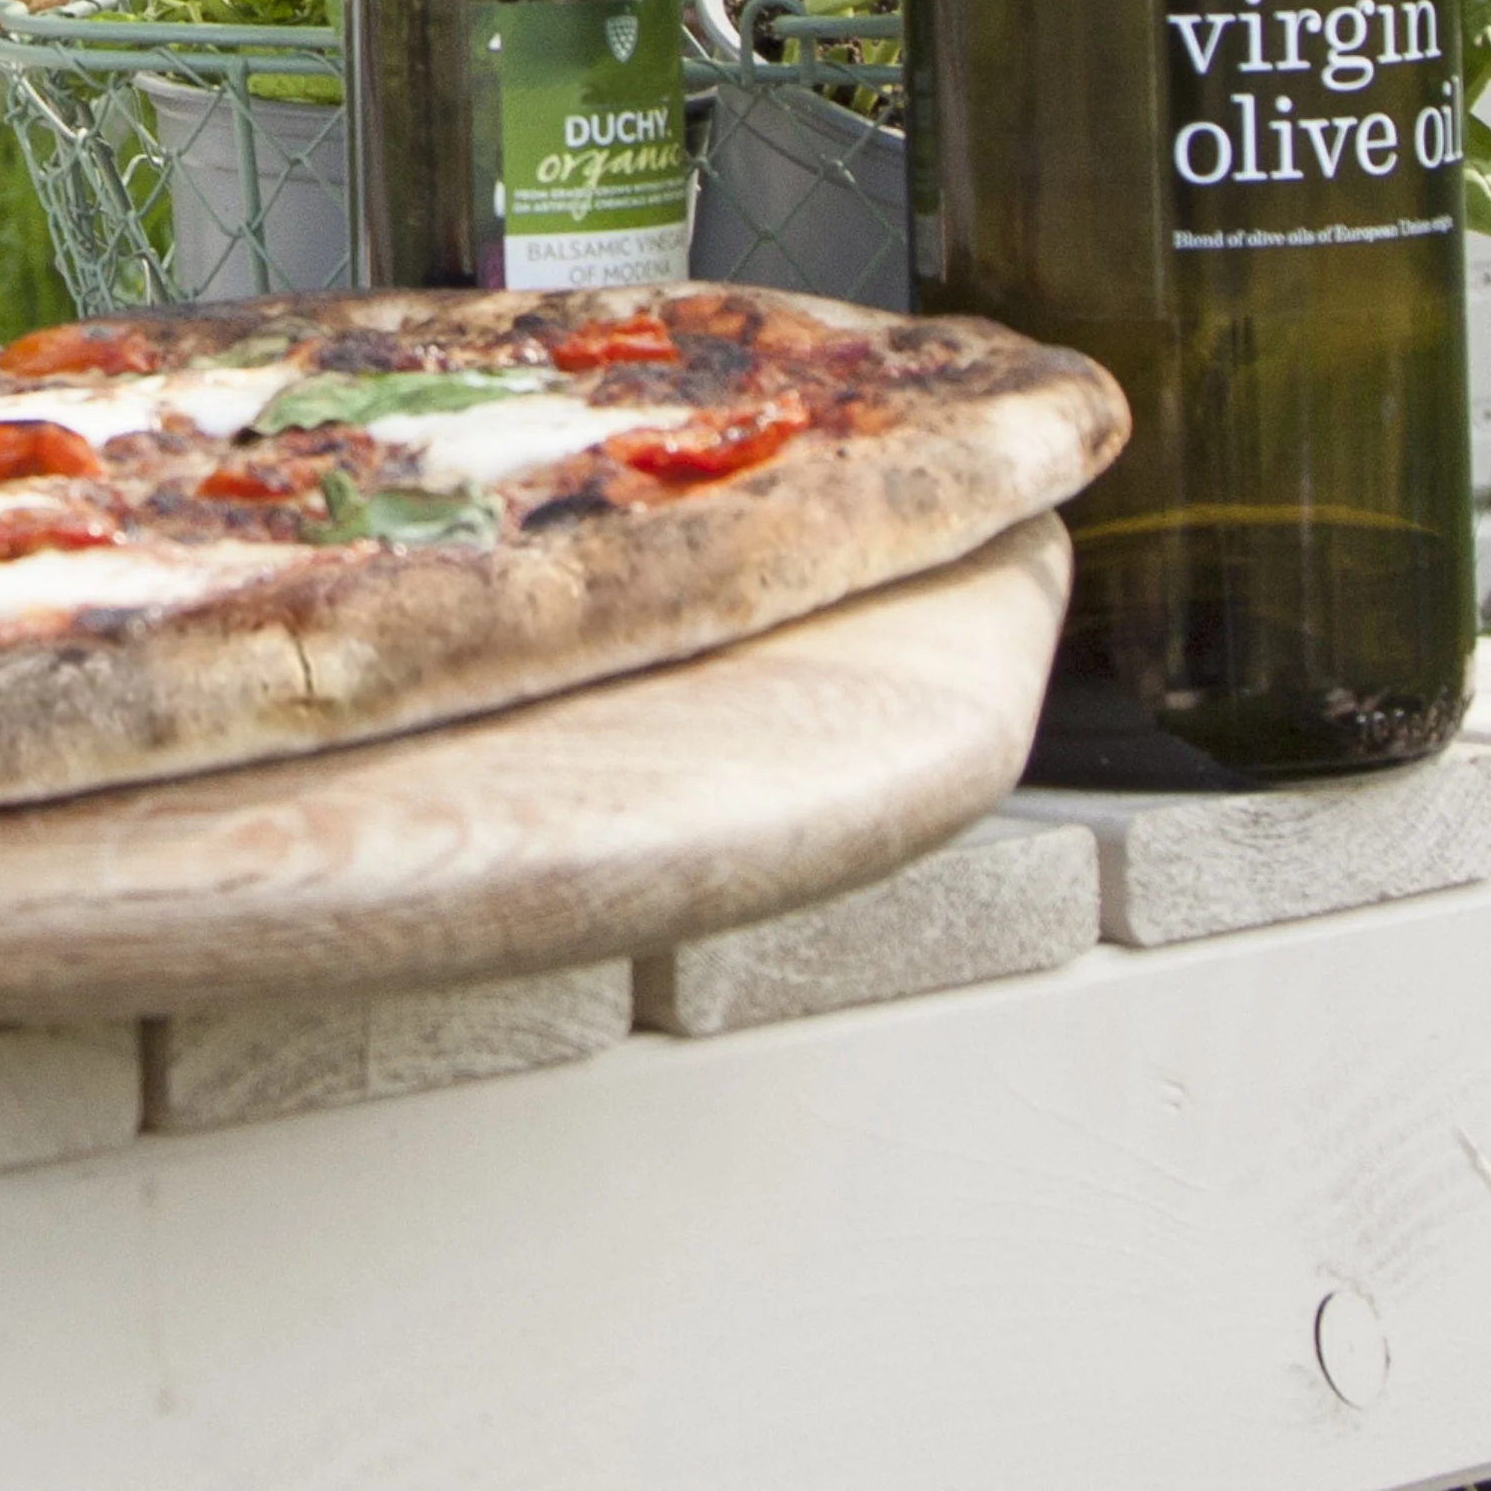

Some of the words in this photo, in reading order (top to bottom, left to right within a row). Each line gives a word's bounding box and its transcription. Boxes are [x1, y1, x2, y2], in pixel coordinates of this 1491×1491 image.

[565, 106, 669, 148] DUCHY
[1173, 93, 1398, 185] olive
[1414, 75, 1464, 171] oil
[536, 141, 682, 220] organic
[526, 235, 632, 262] BALSAMIC
[569, 263, 596, 284] OF
